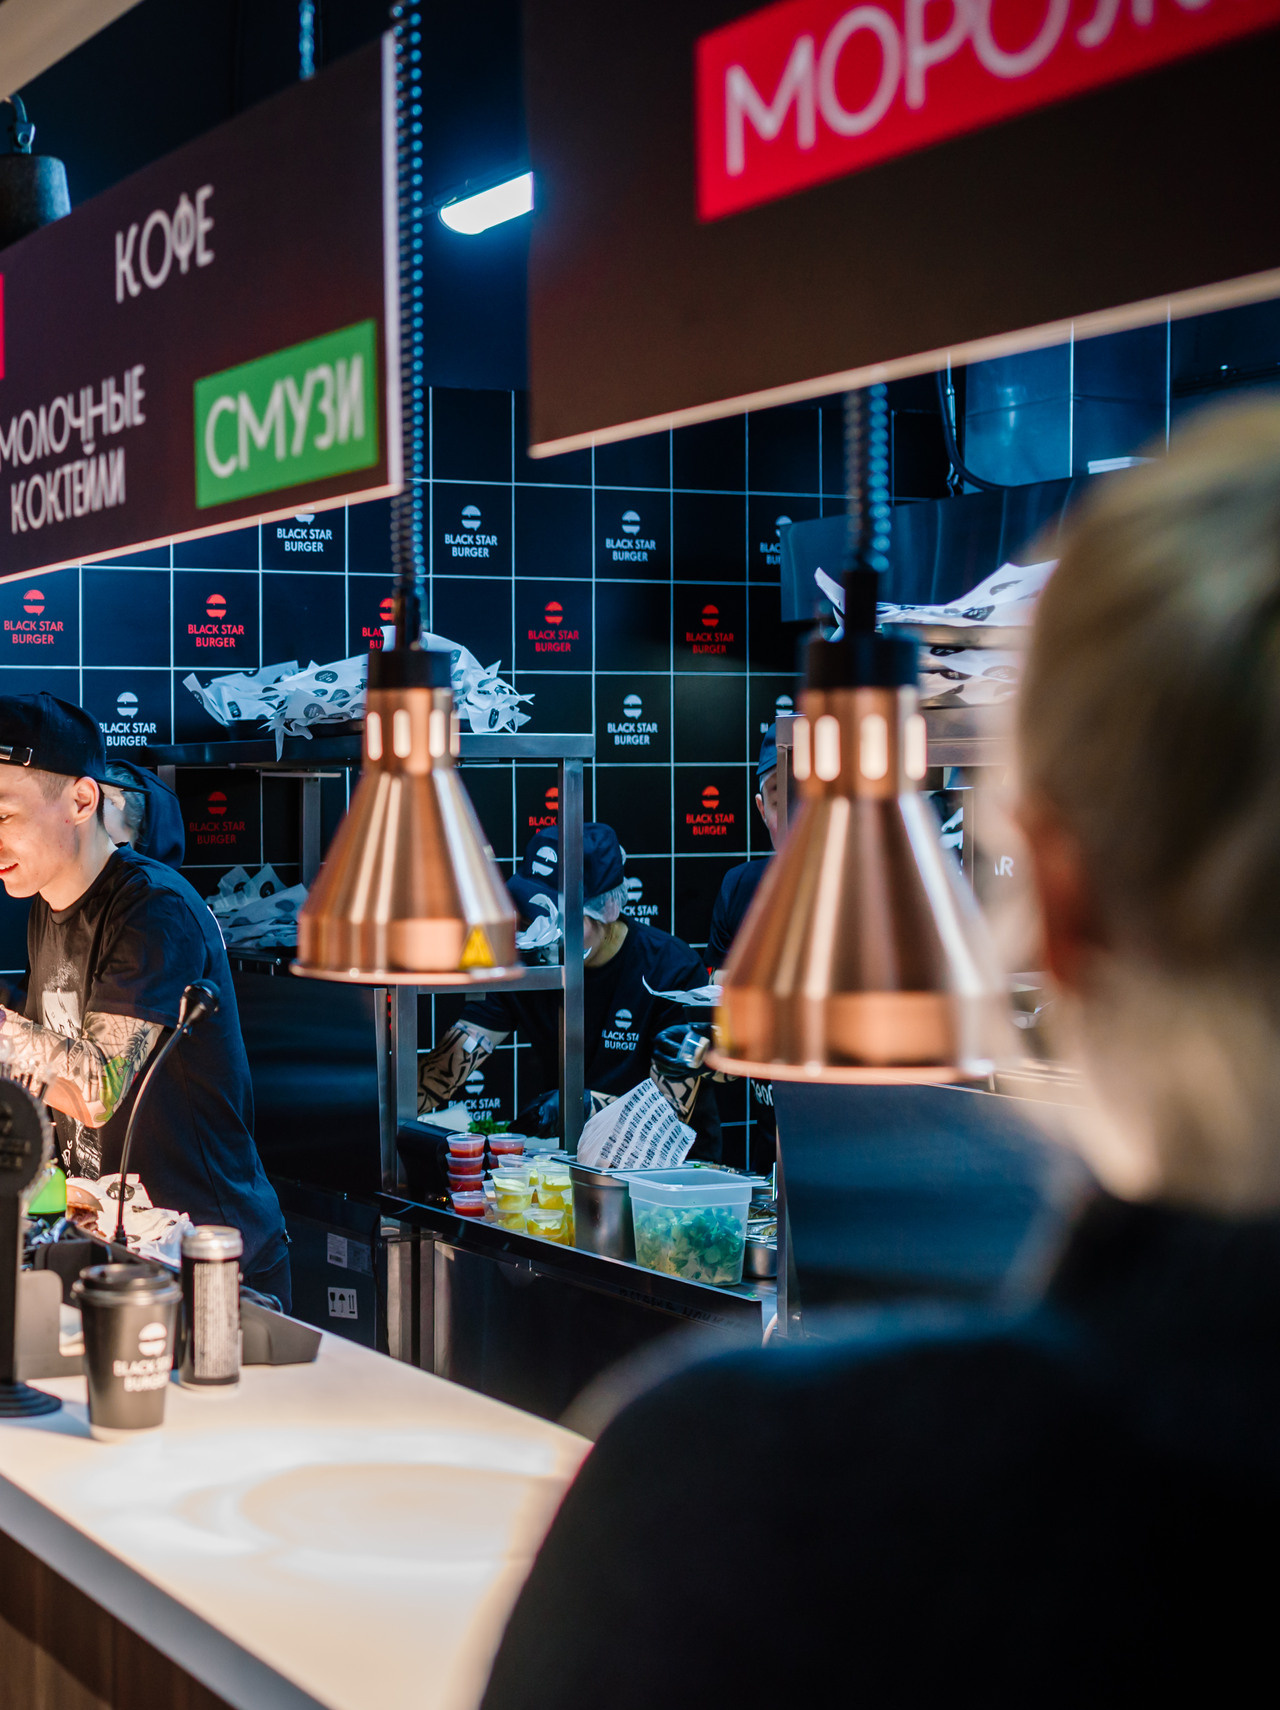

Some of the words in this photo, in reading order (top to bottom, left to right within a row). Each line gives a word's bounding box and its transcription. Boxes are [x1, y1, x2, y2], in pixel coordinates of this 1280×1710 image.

[725, 0, 1214, 177] МОРО
[115, 184, 214, 303] КОФЕ
[204, 353, 365, 478] СМУЗИ
[11, 440, 125, 534] КОКТЕЙЛИ
[277, 528, 305, 540] BLACK
[307, 528, 332, 541] STAR
[444, 534, 474, 546] BLACK
[476, 535, 498, 547] STAR
[284, 540, 323, 553] BURGER
[605, 538, 633, 550] BLACK
[635, 539, 656, 551] STAR
[760, 541, 781, 553] BLAC
[451, 546, 489, 558] BURGER
[612, 549, 648, 562] BURGER
[4, 620, 37, 632] BLACK
[39, 621, 64, 632] STAR
[188, 624, 218, 635] BLACK
[220, 625, 245, 636] STAR
[361, 626, 384, 637] BLAC
[12, 633, 54, 645] BURGER
[528, 630, 556, 641] BLACK
[558, 630, 579, 641] STAR
[686, 631, 713, 643] BLACK
[715, 632, 734, 643] STAR
[195, 637, 236, 648] BURGER
[535, 641, 571, 652] BURGER
[692, 643, 727, 655] BURGER
[132, 722, 157, 733] STAR
[607, 722, 635, 733] BLACK
[637, 722, 658, 734] STAR
[106, 735, 147, 746] BURGER
[614, 733, 650, 746] BURGER
[528, 816, 557, 826] BLACK
[686, 814, 713, 825] BLACK
[715, 814, 735, 825] STAR
[189, 821, 220, 832] BLACK
[222, 821, 246, 832] STAR
[692, 825, 727, 836] BURGER
[196, 834, 237, 845] BURGER
[637, 904, 658, 916] STAR
[478, 1098, 501, 1109] STAR
